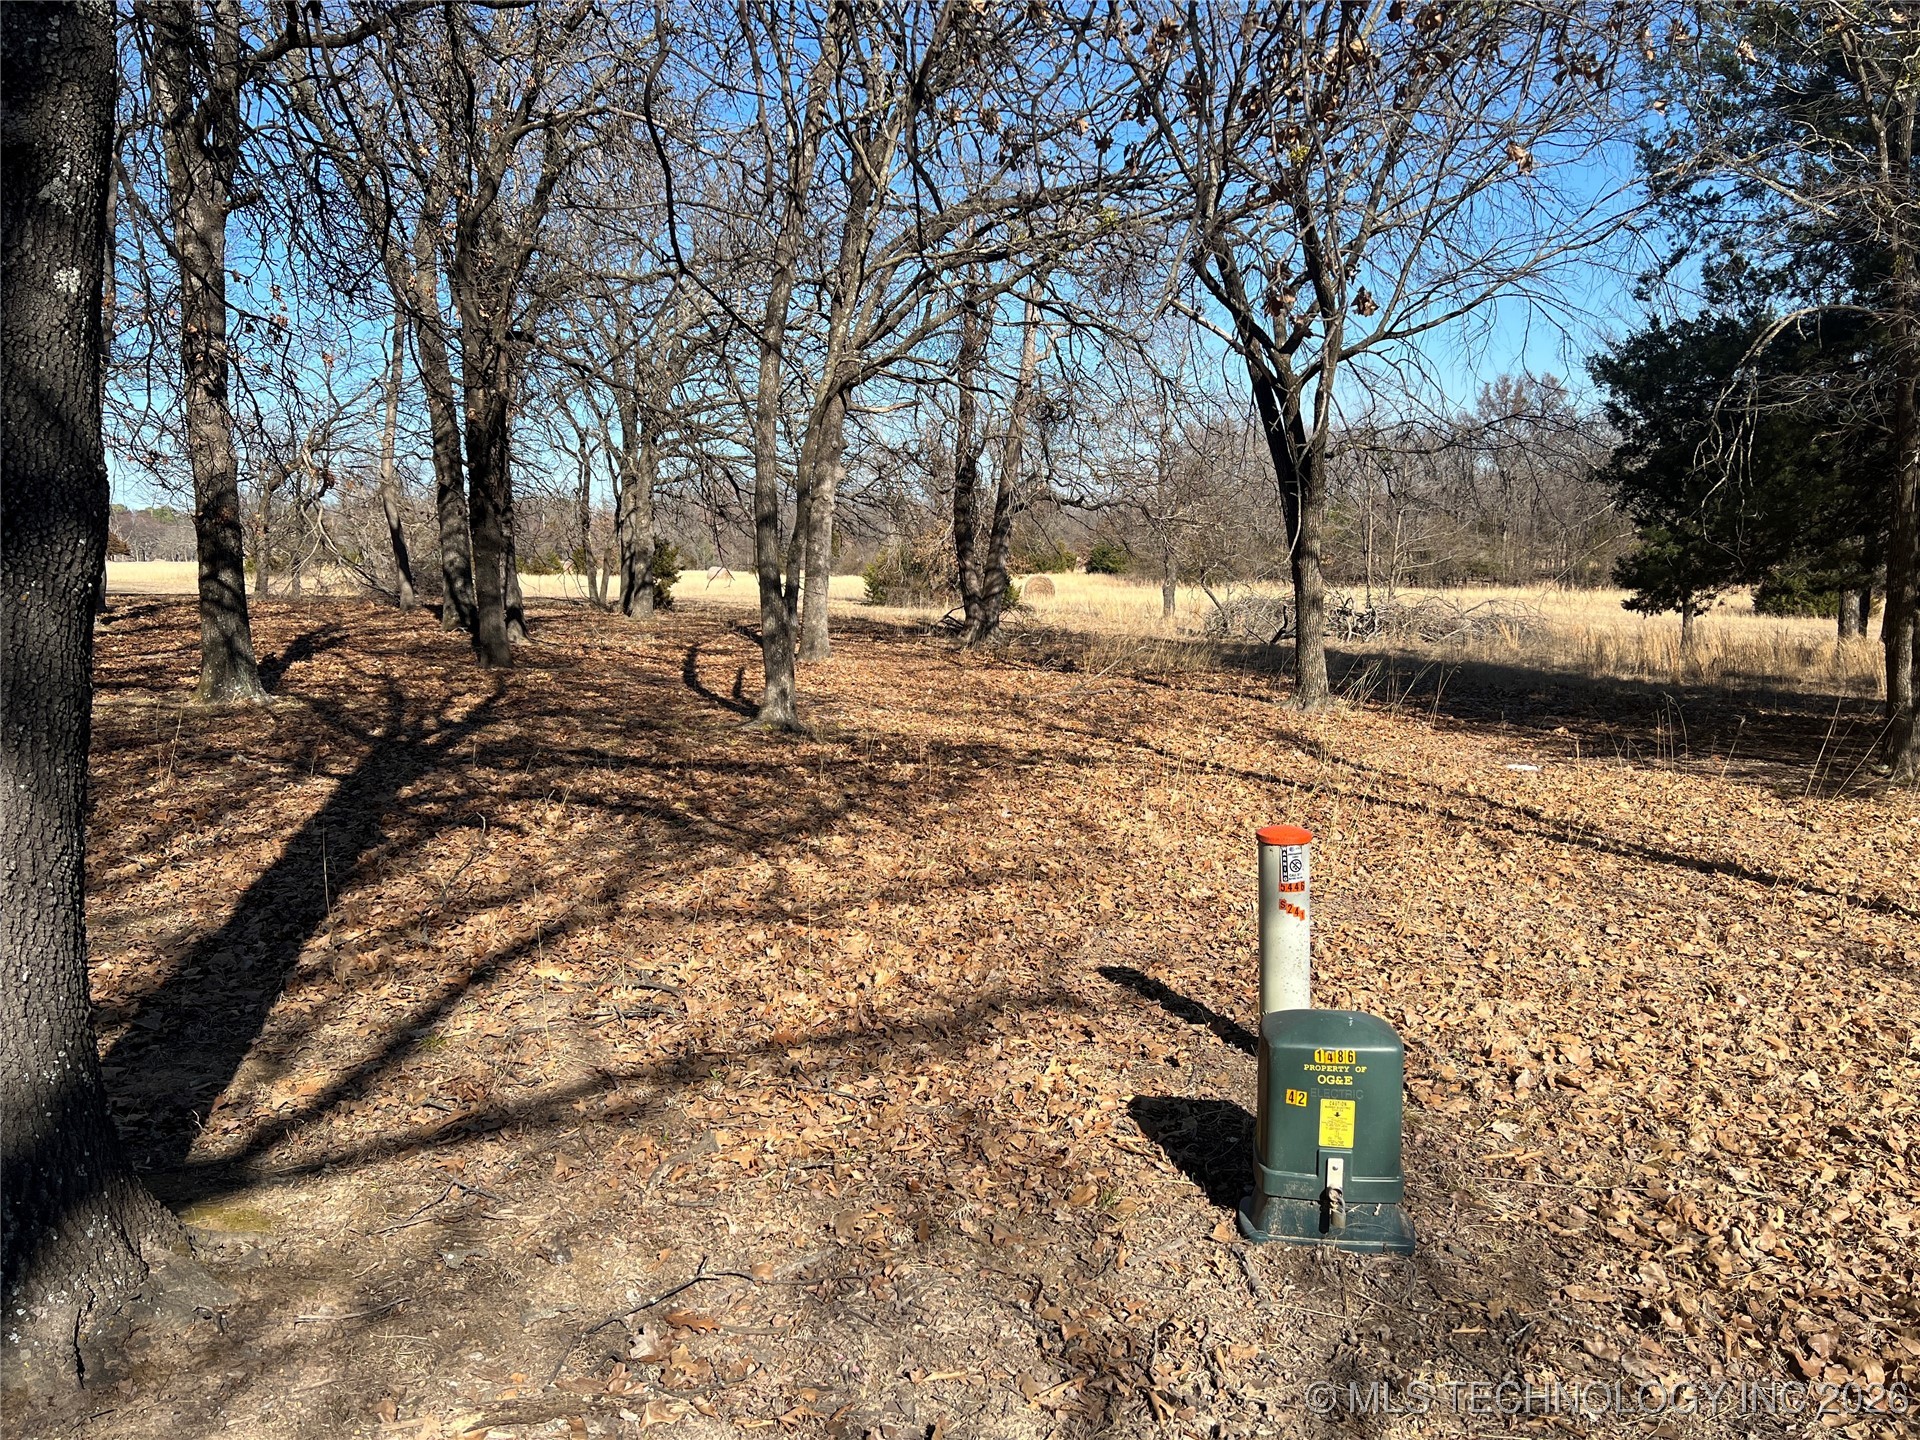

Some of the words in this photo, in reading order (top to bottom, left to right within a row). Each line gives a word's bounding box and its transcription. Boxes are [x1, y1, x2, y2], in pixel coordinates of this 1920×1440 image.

[1280, 882, 1305, 892] 5446
[1280, 899, 1304, 919] S241
[1317, 1050, 1354, 1063] 1486
[1304, 1064, 1350, 1072] PROPERTY
[1317, 1074, 1353, 1085] OG&E
[1288, 1090, 1305, 1105] 42
[1311, 1088, 1364, 1099] ELECTRIC
